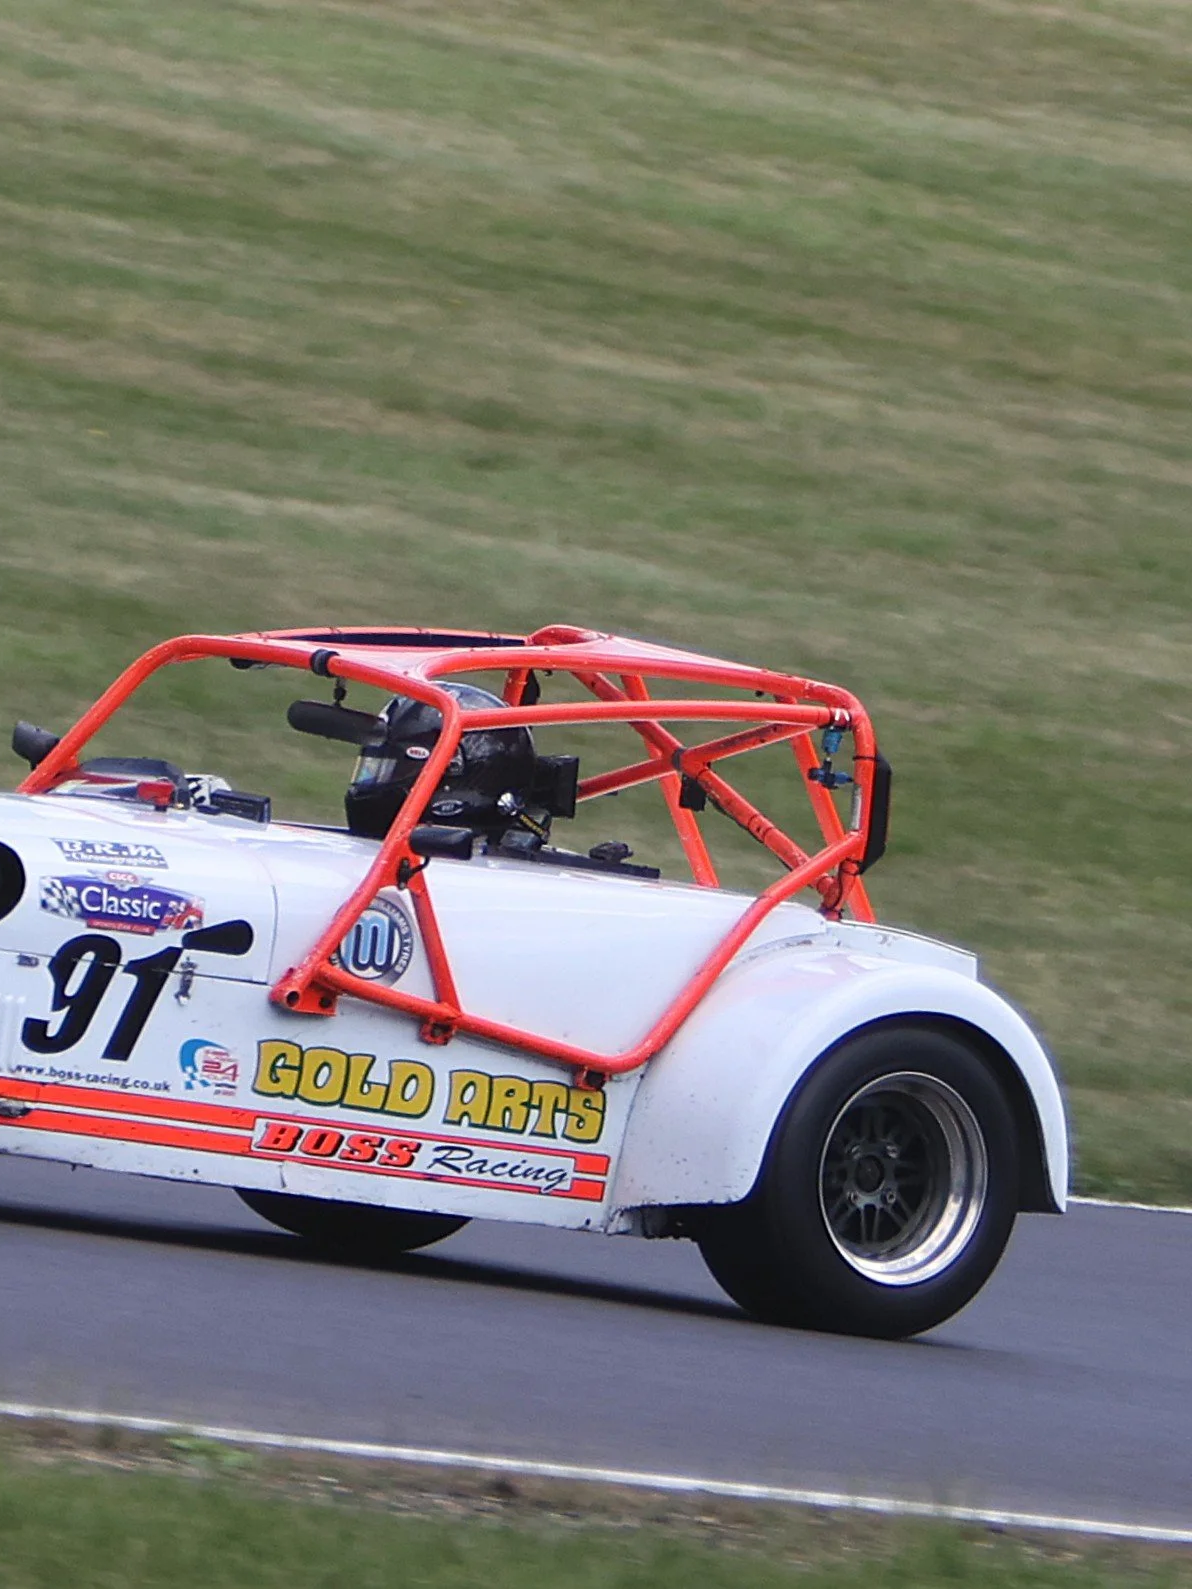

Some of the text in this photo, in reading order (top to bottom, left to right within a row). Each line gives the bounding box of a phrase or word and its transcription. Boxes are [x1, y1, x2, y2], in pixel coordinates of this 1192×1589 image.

[80, 885, 161, 920] Classic
[21, 934, 184, 1062] 91
[14, 1062, 171, 1093] www.boss-racing.co.uk
[202, 1059, 238, 1082] 24
[252, 1038, 606, 1144] GOLD ARTS
[254, 1121, 568, 1192] BOSS Racing
